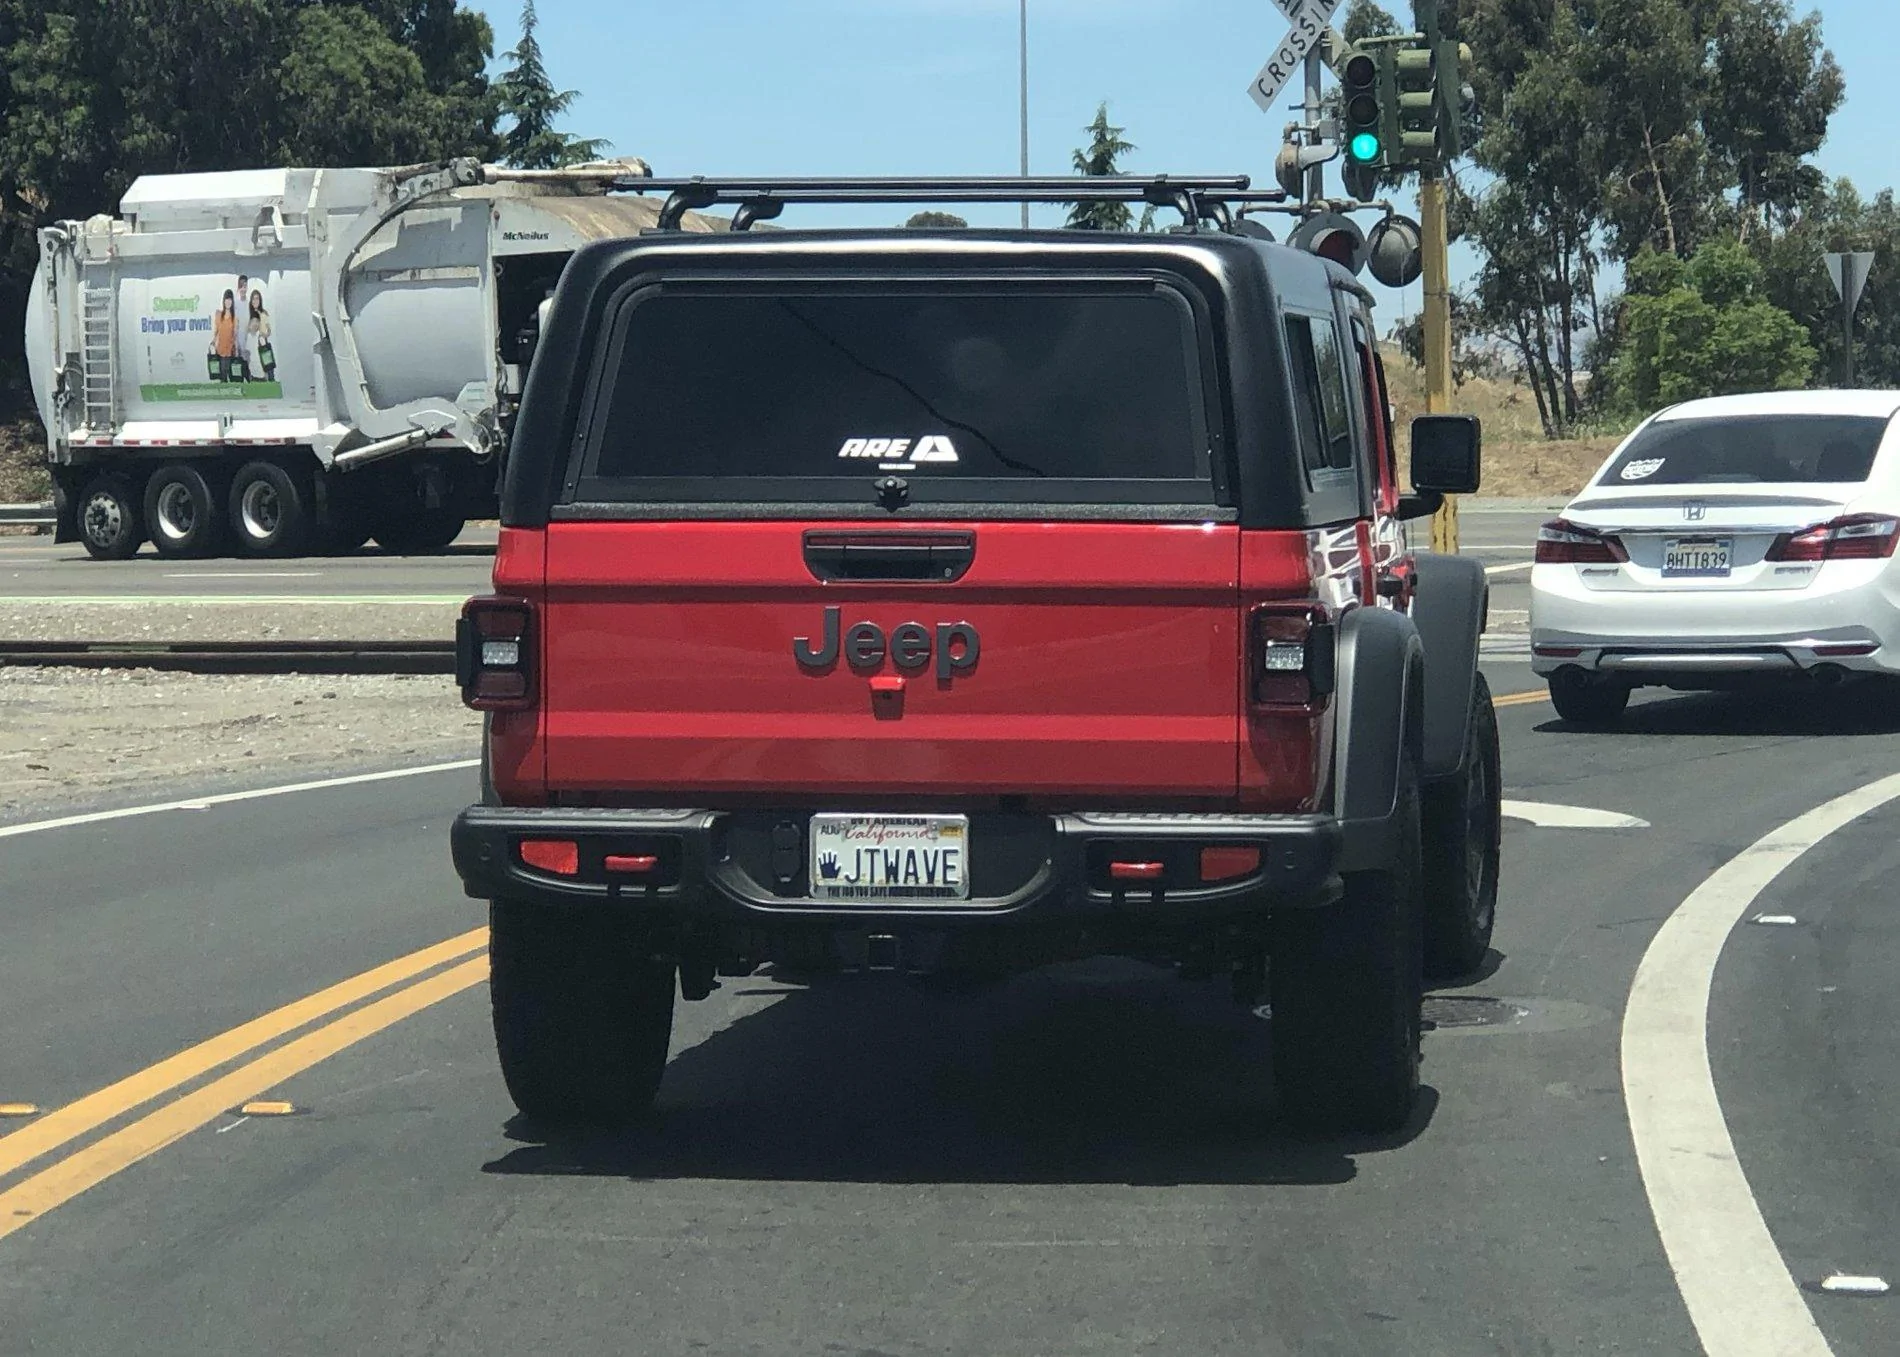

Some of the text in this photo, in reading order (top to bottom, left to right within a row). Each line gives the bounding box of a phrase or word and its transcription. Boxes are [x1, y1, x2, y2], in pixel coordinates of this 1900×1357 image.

[141, 315, 212, 334] Bring your own!
[793, 605, 981, 681] Jeep
[844, 824, 937, 845] California
[844, 848, 959, 884] JTWAVE
